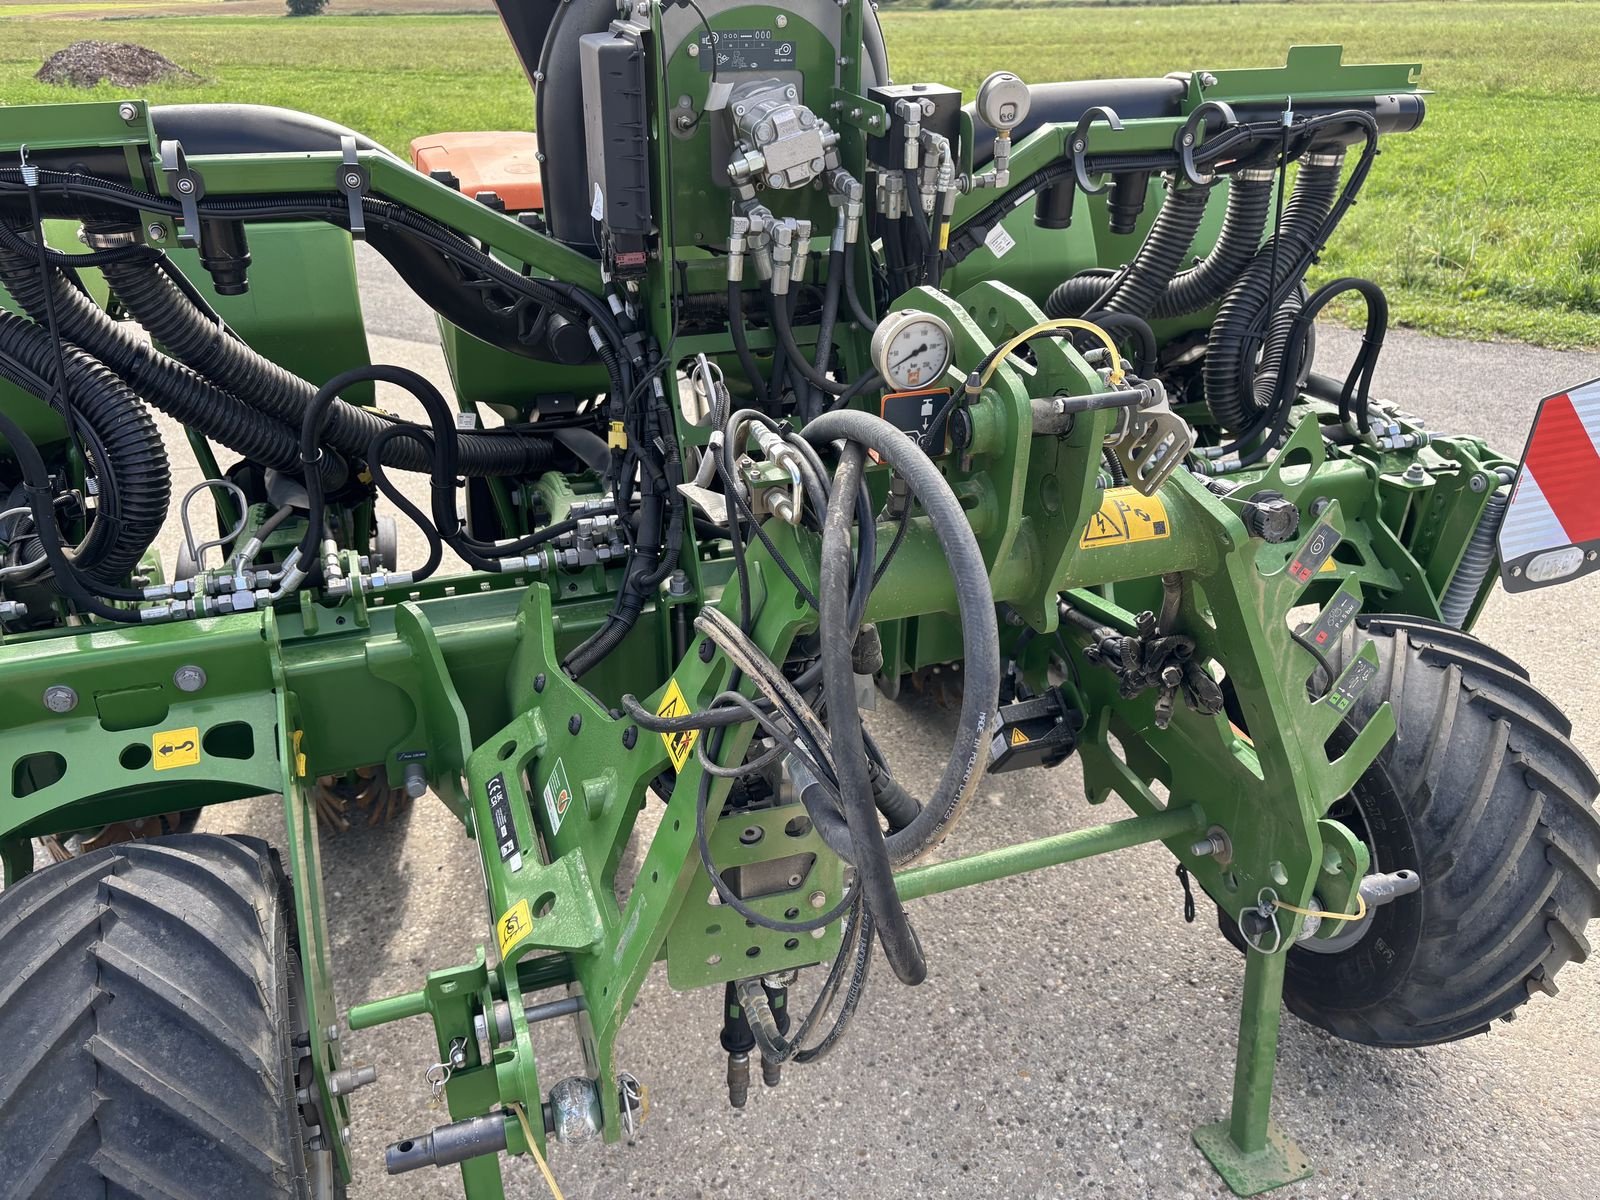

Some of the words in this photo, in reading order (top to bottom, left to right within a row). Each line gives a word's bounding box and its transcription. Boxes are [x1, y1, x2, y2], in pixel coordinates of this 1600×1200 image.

[1345, 604, 1354, 615] bar
[977, 711, 987, 734] MADE
[973, 737, 982, 749] IN
[962, 751, 978, 782] POLAND
[488, 778, 501, 796] CE
